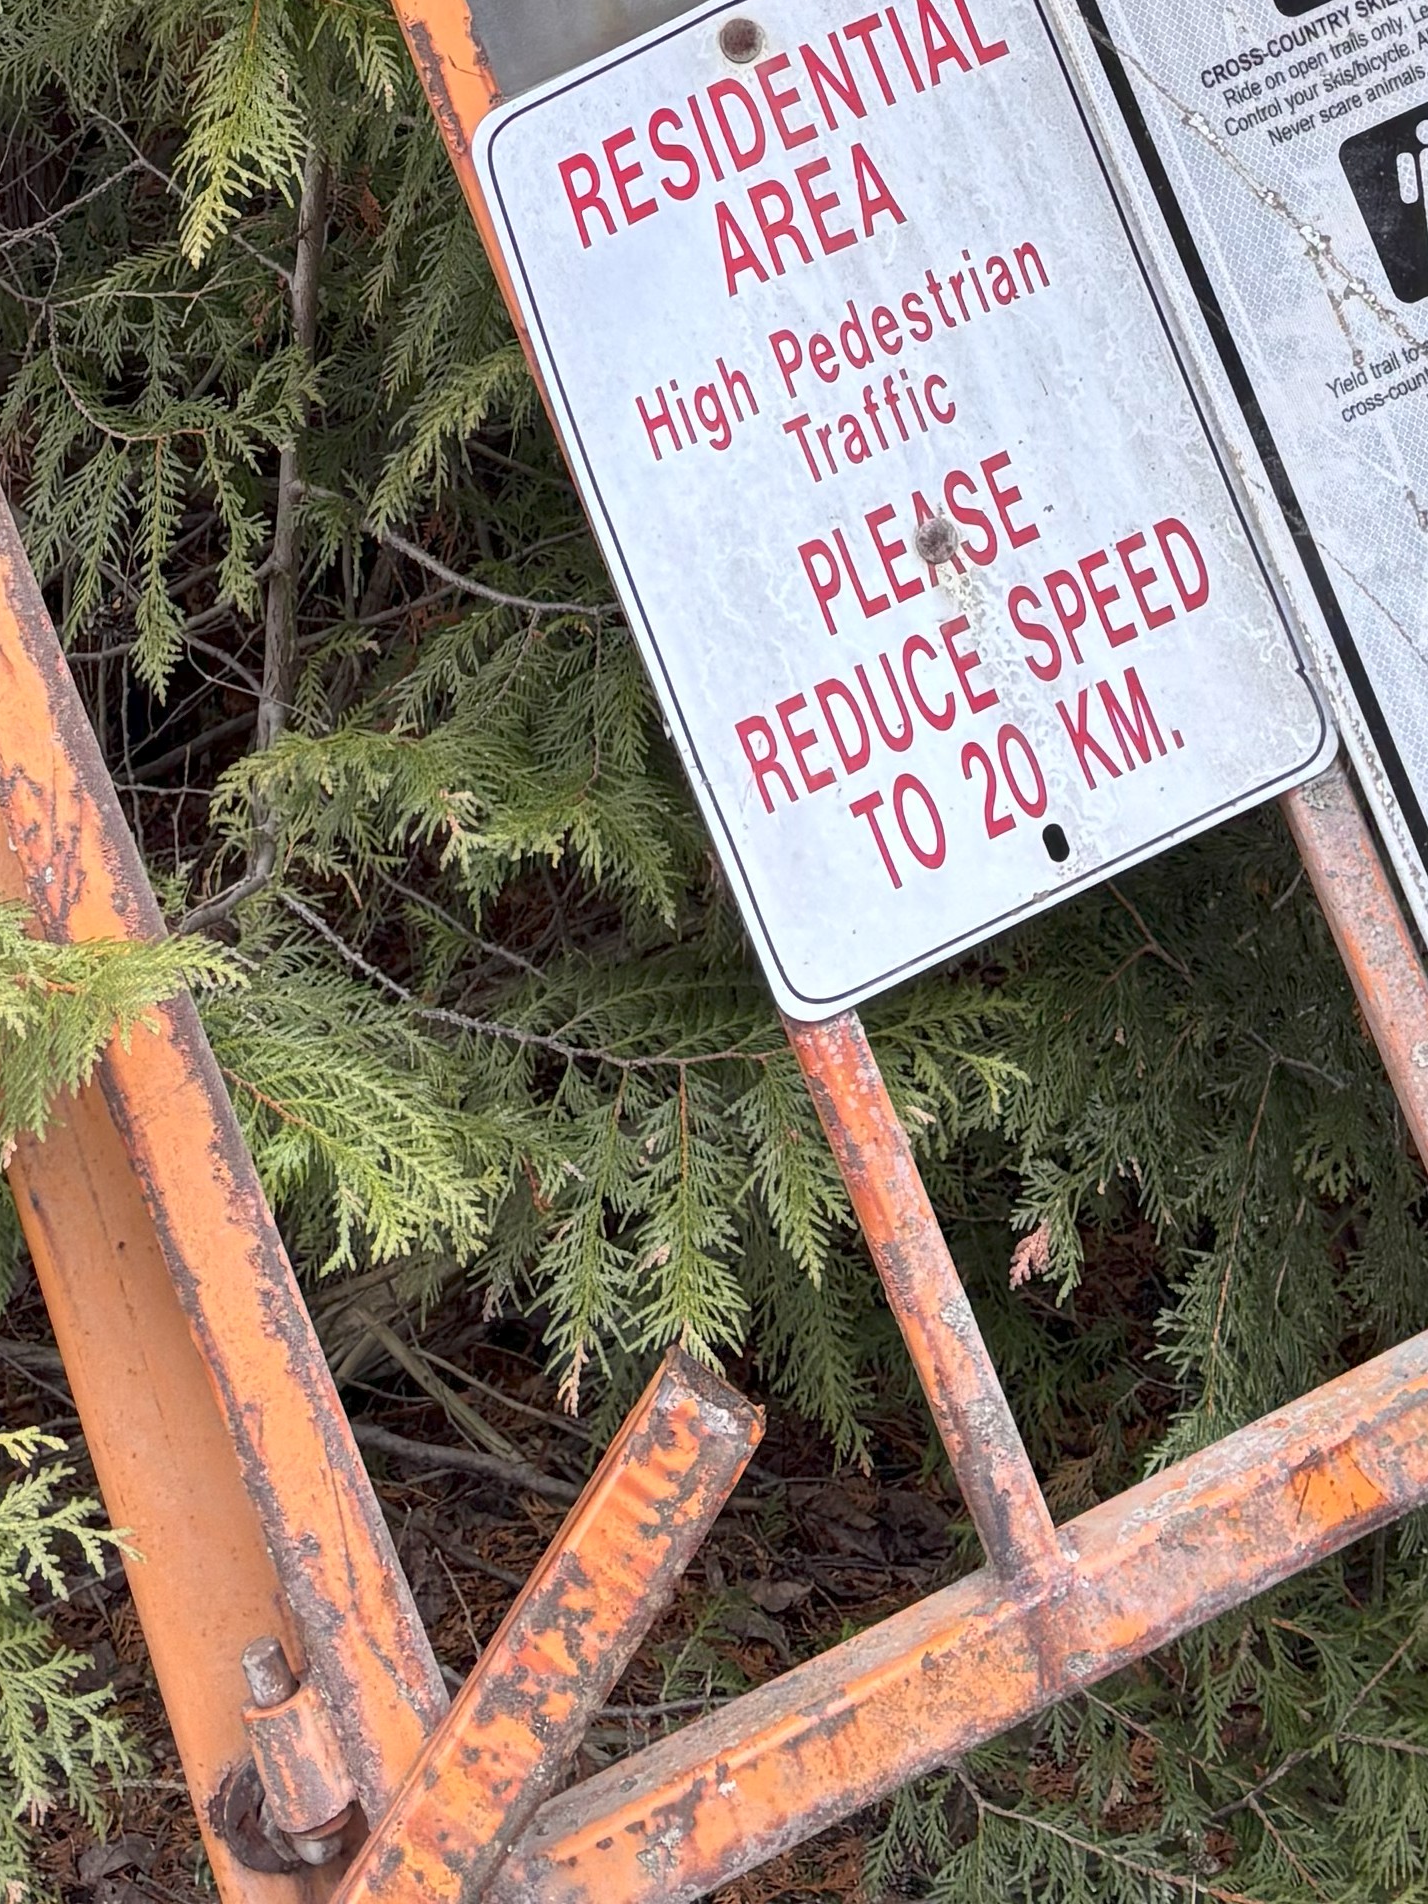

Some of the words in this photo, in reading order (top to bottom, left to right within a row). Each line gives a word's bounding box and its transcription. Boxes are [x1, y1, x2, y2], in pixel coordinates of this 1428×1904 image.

[1200, 4, 1350, 88] CROSS-COUNTRY
[1221, 79, 1262, 109] Ride
[1264, 70, 1287, 90] on
[1287, 50, 1329, 79] open
[1328, 31, 1369, 60] trails
[1370, 15, 1408, 41] only.
[1223, 96, 1283, 137] Control
[1282, 82, 1319, 115] your
[1318, 41, 1415, 93] skis/bicycle.
[1266, 113, 1316, 147] Never
[1318, 93, 1363, 124] scare
[714, 142, 904, 295] AREA
[635, 359, 757, 459] High
[768, 241, 1047, 395] Pedestrian
[1324, 364, 1369, 399] Yield
[1368, 349, 1401, 379] trail
[1400, 342, 1421, 365] to
[782, 373, 955, 481] Traffic
[797, 451, 1039, 634] PLEASE
[734, 615, 998, 813] REDUCE
[1007, 517, 1209, 681] SPEED
[849, 772, 946, 888] TO
[960, 723, 1047, 839] 20
[1055, 667, 1182, 788] KM.
